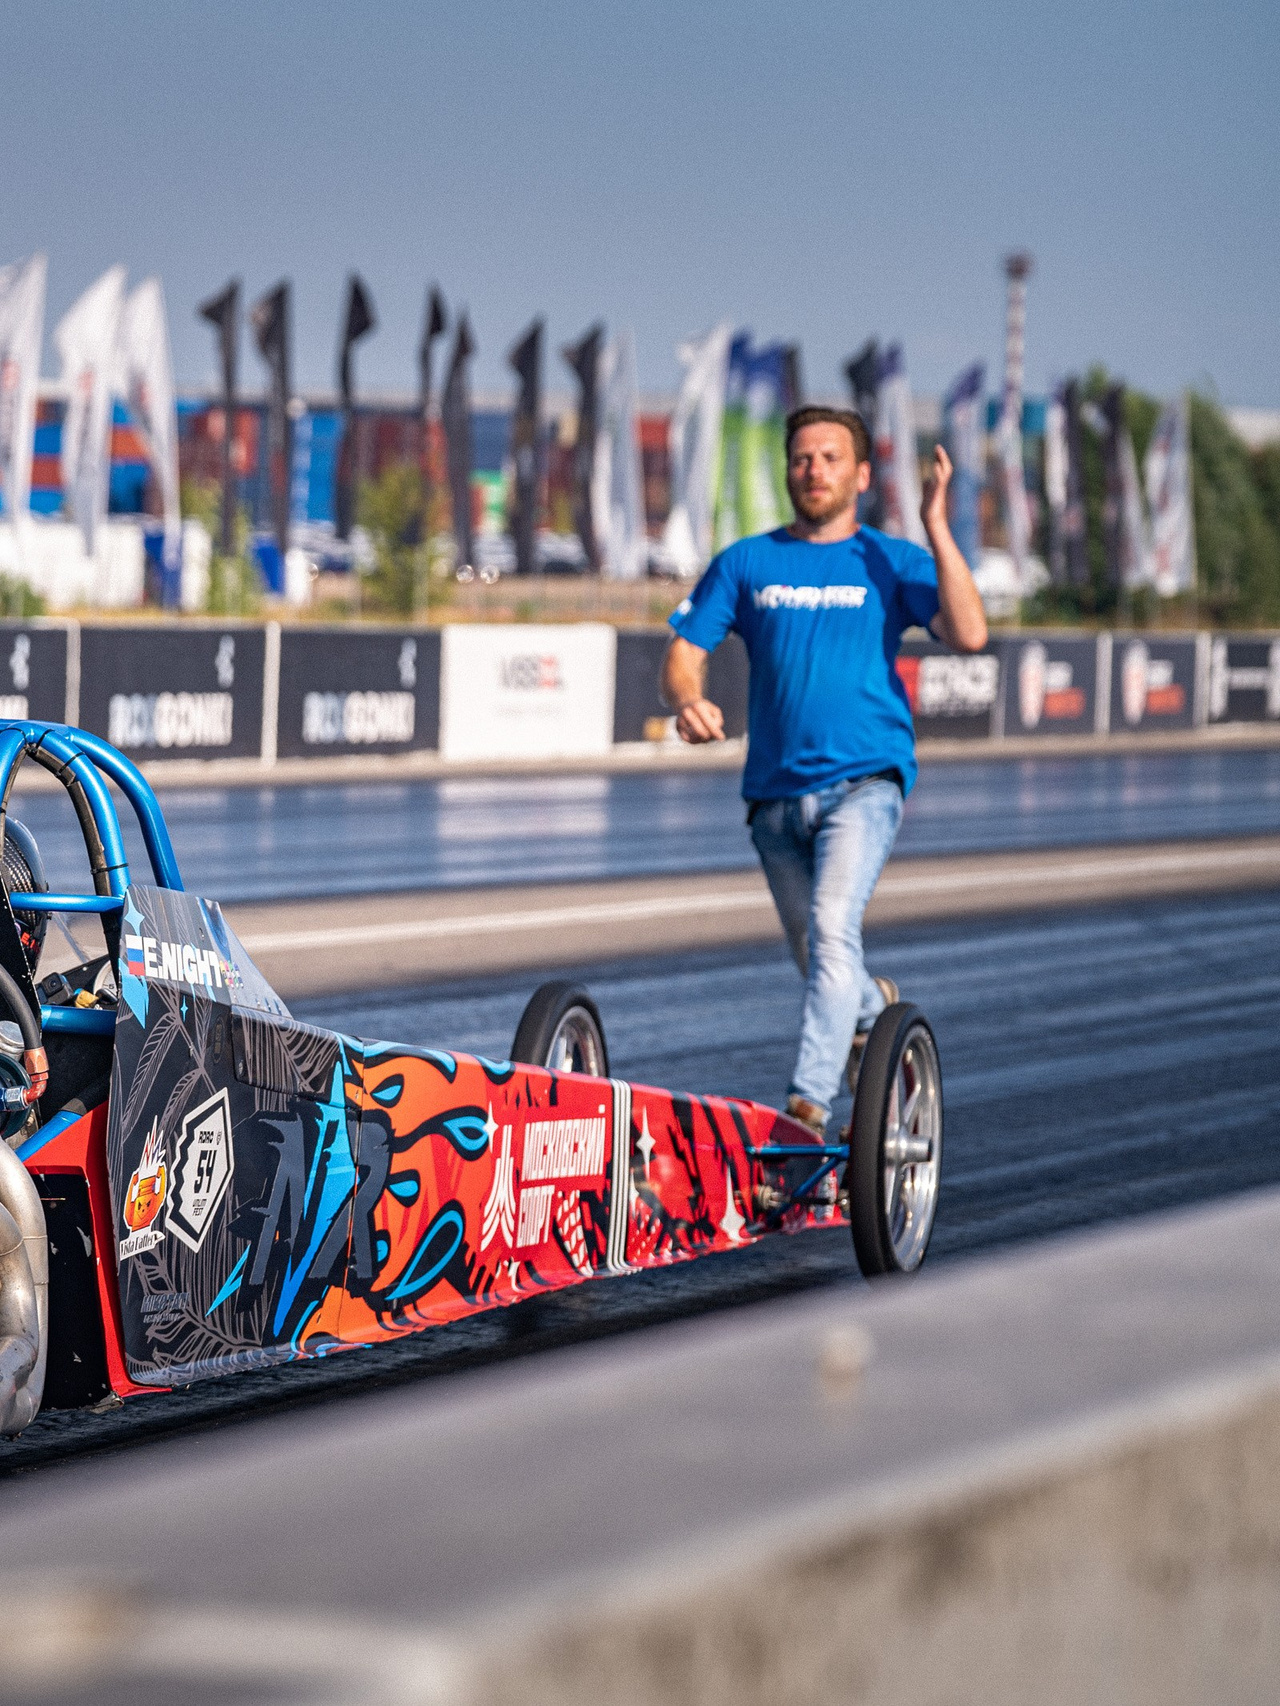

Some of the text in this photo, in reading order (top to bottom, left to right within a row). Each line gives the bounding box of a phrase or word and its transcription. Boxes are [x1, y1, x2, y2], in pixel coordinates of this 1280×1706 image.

[521, 1104, 606, 1182] МОСКОВСКИЙ
[194, 1150, 217, 1193] 54
[192, 1207, 204, 1216] FEST
[516, 1184, 555, 1248] СПОРТ
